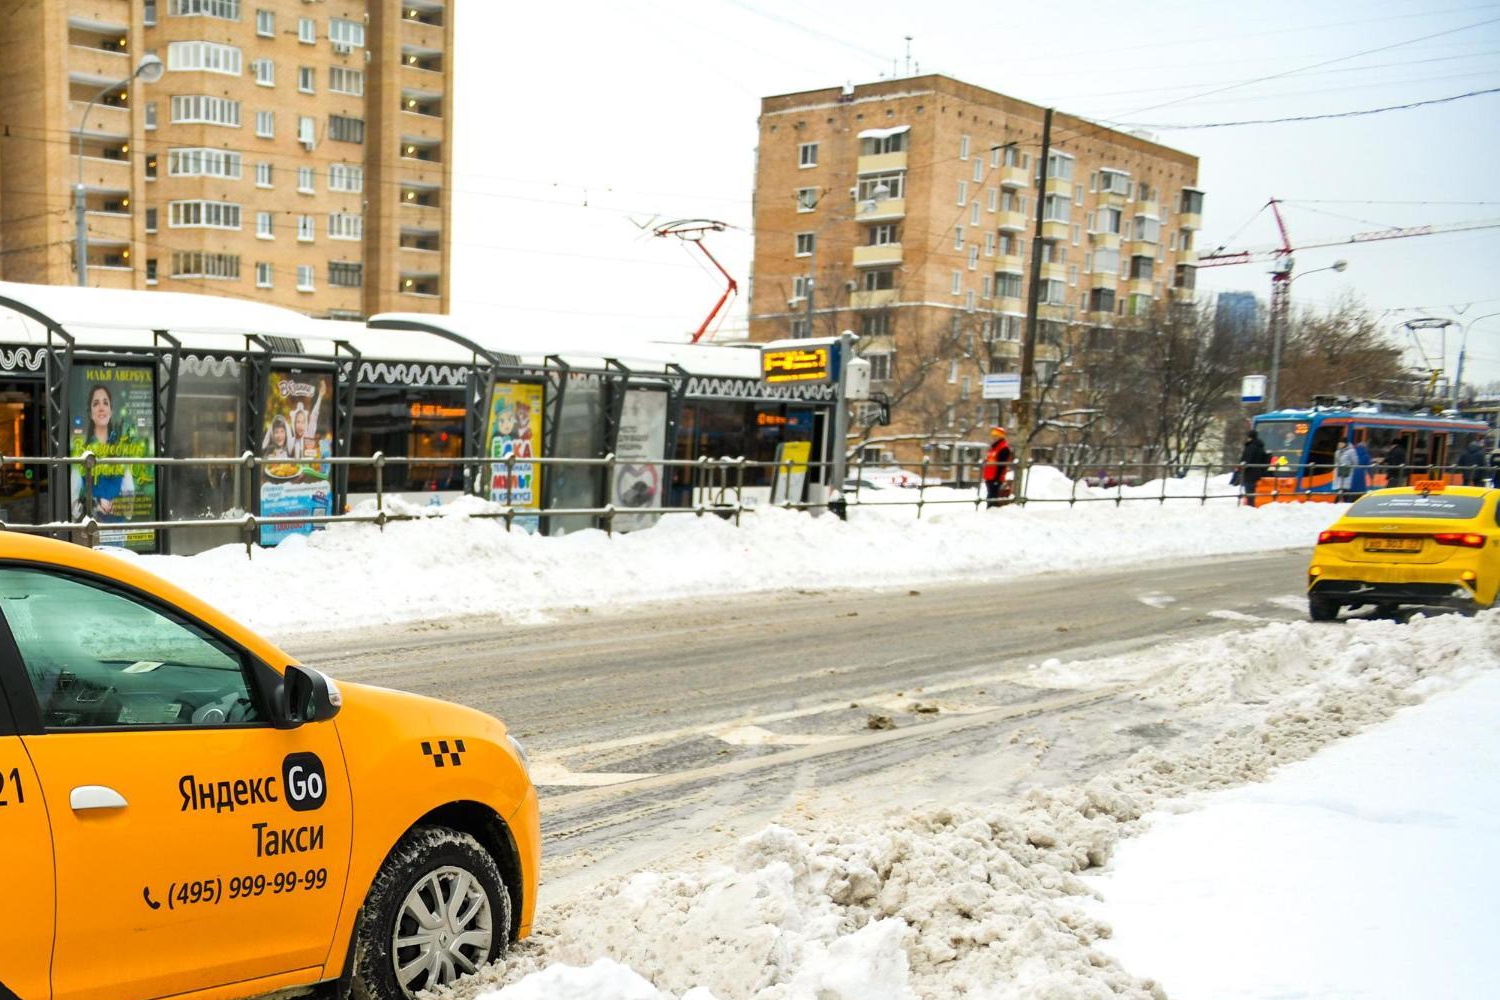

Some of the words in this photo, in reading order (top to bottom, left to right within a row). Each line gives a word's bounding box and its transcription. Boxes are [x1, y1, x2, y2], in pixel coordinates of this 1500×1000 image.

[179, 775, 278, 813] Яндекс
[288, 766, 323, 801] Go
[252, 822, 324, 857] Такси
[168, 878, 222, 910] (495)
[229, 868, 327, 899] 999-99-99
